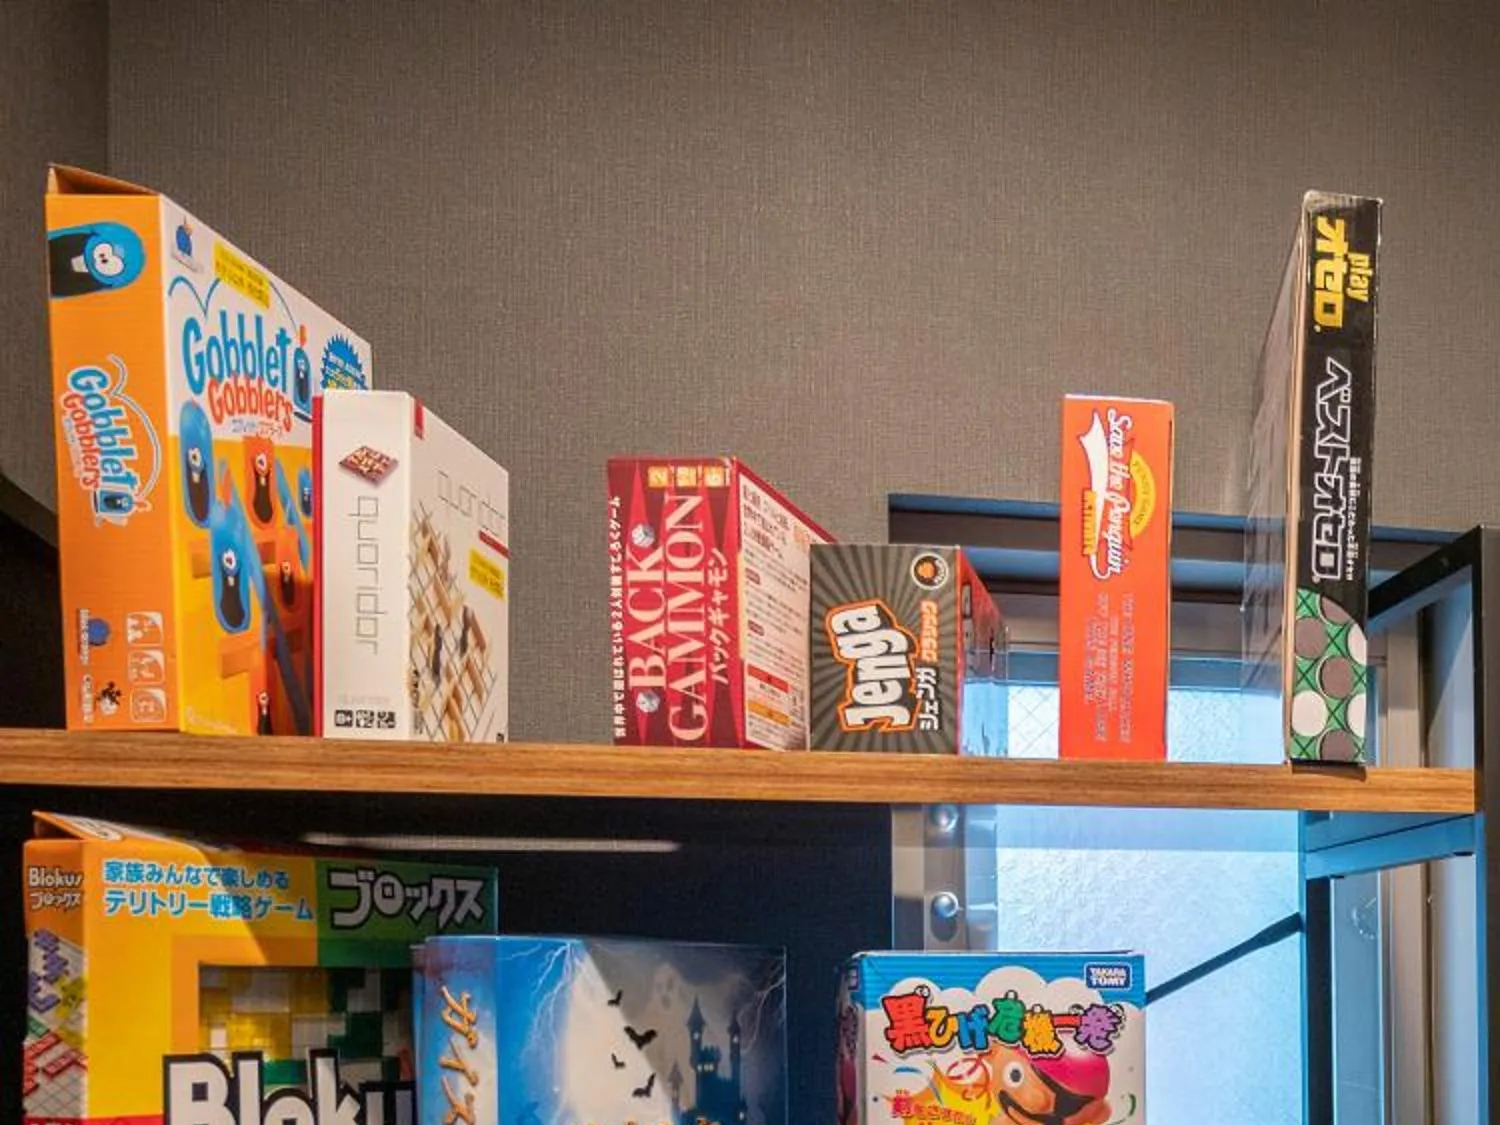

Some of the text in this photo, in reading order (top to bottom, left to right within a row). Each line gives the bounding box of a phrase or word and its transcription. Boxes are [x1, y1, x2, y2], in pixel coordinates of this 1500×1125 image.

[1314, 216, 1349, 330] オセロ
[182, 309, 292, 395] Gobblet
[68, 367, 139, 490] Gobblet
[208, 370, 294, 432] Gobblers
[1107, 408, 1132, 458] Save
[62, 391, 100, 490] Gobblers
[1109, 462, 1130, 490] the
[1102, 491, 1131, 575] Penguin
[626, 546, 667, 691] BACK
[664, 493, 708, 742] GAMMON
[707, 547, 729, 685] バックギャモン
[831, 605, 911, 727] Jenga
[28, 866, 83, 888] Blokus
[30, 892, 82, 912] ブロックス
[104, 860, 290, 890] 家族みんなで楽しめる
[104, 889, 315, 920] テリトリー戦略ゲーム
[329, 867, 486, 930] ブロックス
[1090, 977, 1126, 987] TOMY
